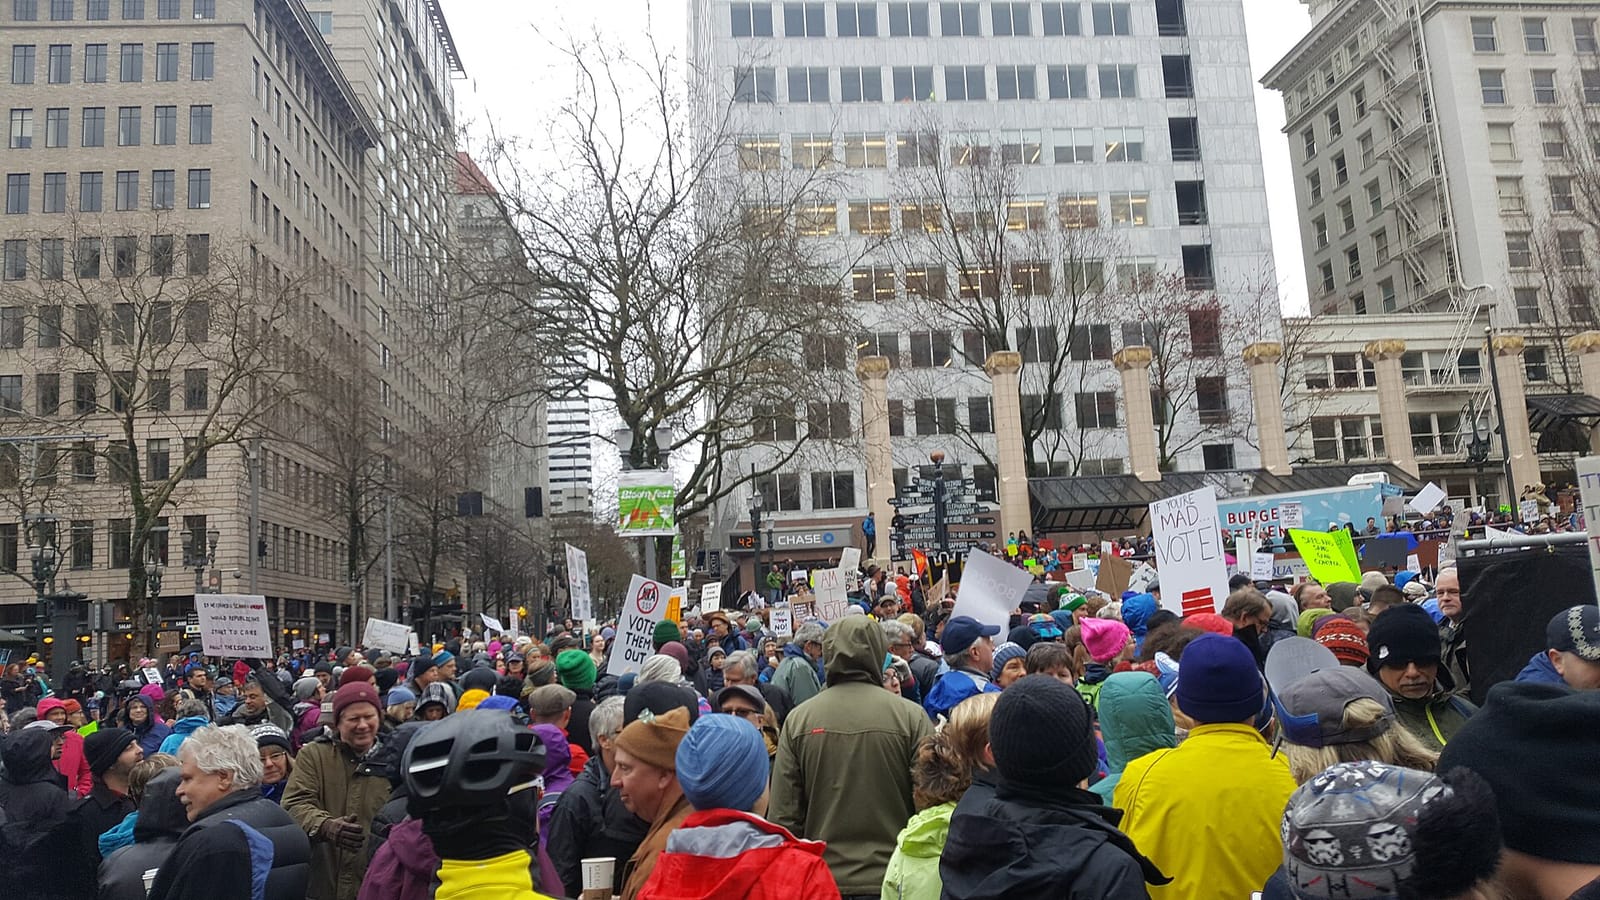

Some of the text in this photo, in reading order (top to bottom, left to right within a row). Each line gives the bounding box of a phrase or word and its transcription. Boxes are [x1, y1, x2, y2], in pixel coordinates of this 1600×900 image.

[1228, 507, 1279, 524] BURGE
[778, 534, 821, 545] CHASE
[821, 570, 838, 588] AM
[629, 615, 656, 636] VOTE
[626, 631, 651, 651] THEM
[625, 648, 647, 665] OUT
